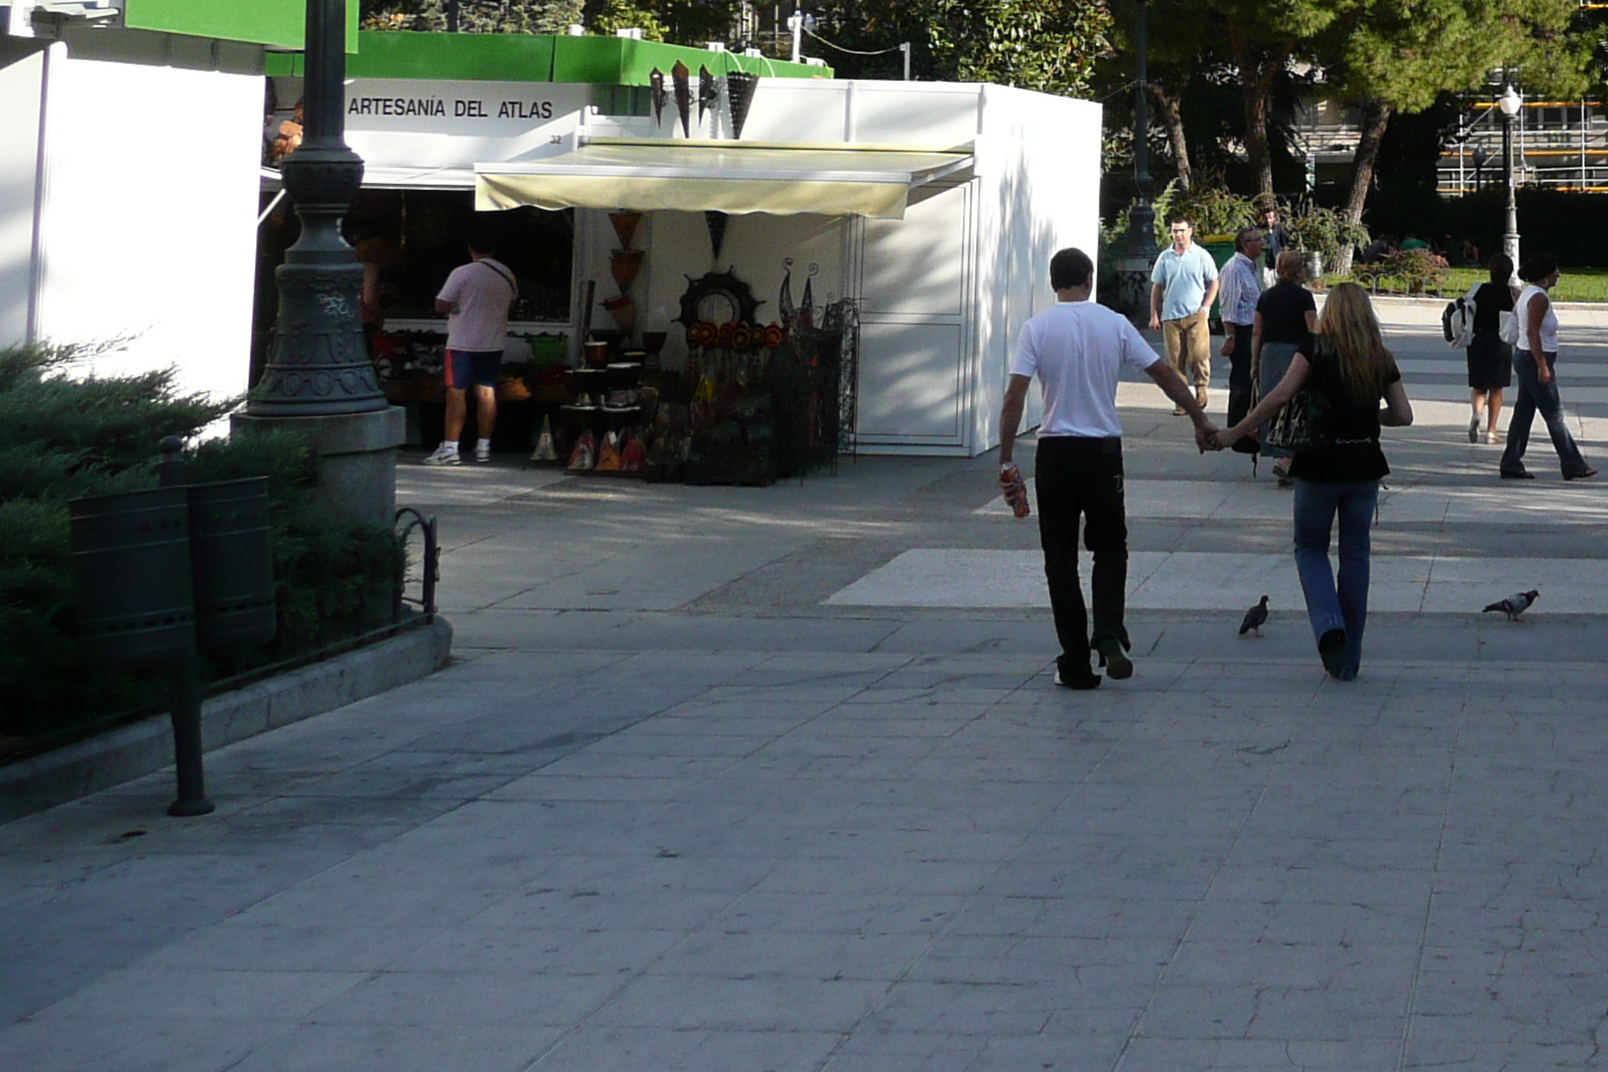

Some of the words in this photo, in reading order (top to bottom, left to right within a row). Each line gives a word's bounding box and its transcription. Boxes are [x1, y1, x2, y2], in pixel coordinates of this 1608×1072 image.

[348, 95, 445, 116] ARTESANÍA
[454, 101, 487, 118] DEL
[498, 101, 552, 119] ATLAS
